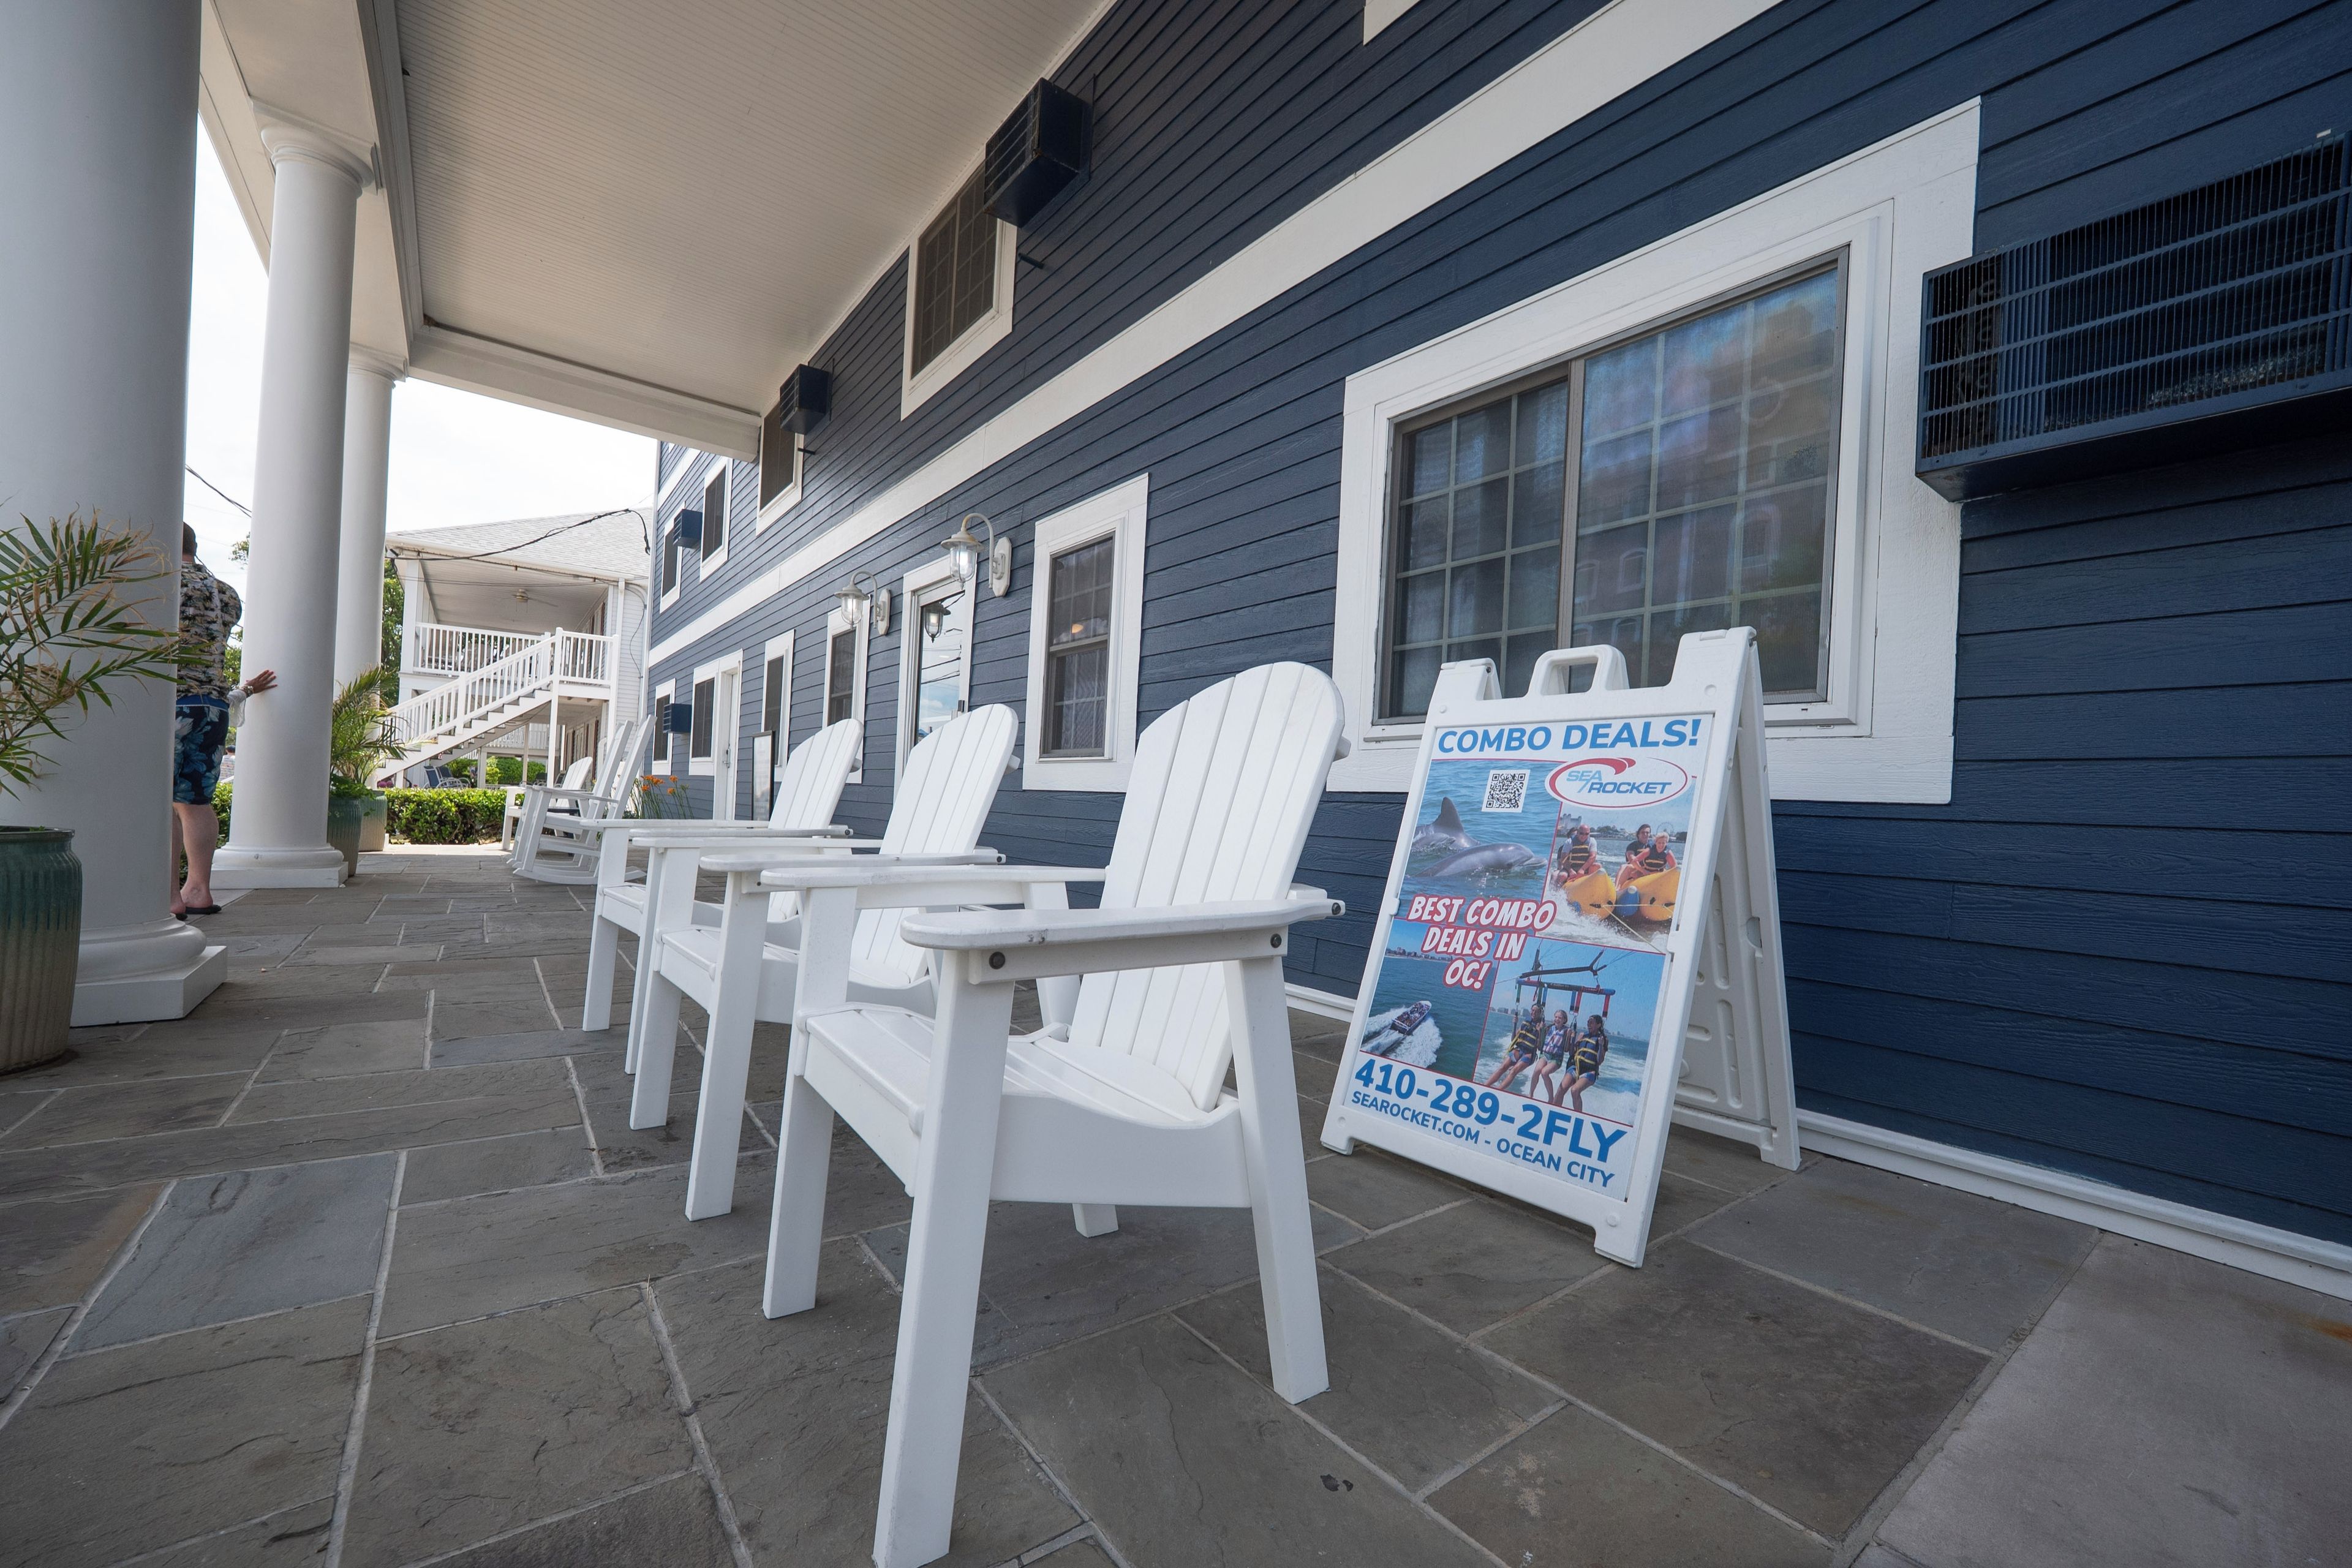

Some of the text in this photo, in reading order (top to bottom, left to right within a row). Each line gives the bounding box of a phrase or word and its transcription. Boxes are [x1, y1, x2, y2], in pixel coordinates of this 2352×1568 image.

[1438, 718, 1702, 753] COMBO DEALS!
[1566, 769, 1603, 783] SEA
[1588, 782, 1672, 794] ROCKET
[1408, 895, 1555, 930] BEST COMBO
[1422, 927, 1526, 959] DEALS IN
[1444, 959, 1491, 989] OC!
[1354, 1058, 1628, 1164] 410-289-2FLY
[1351, 1090, 1481, 1145] SEAROCKET.COM
[1496, 1137, 1562, 1172] OCEAN
[1566, 1161, 1616, 1188] CITY
